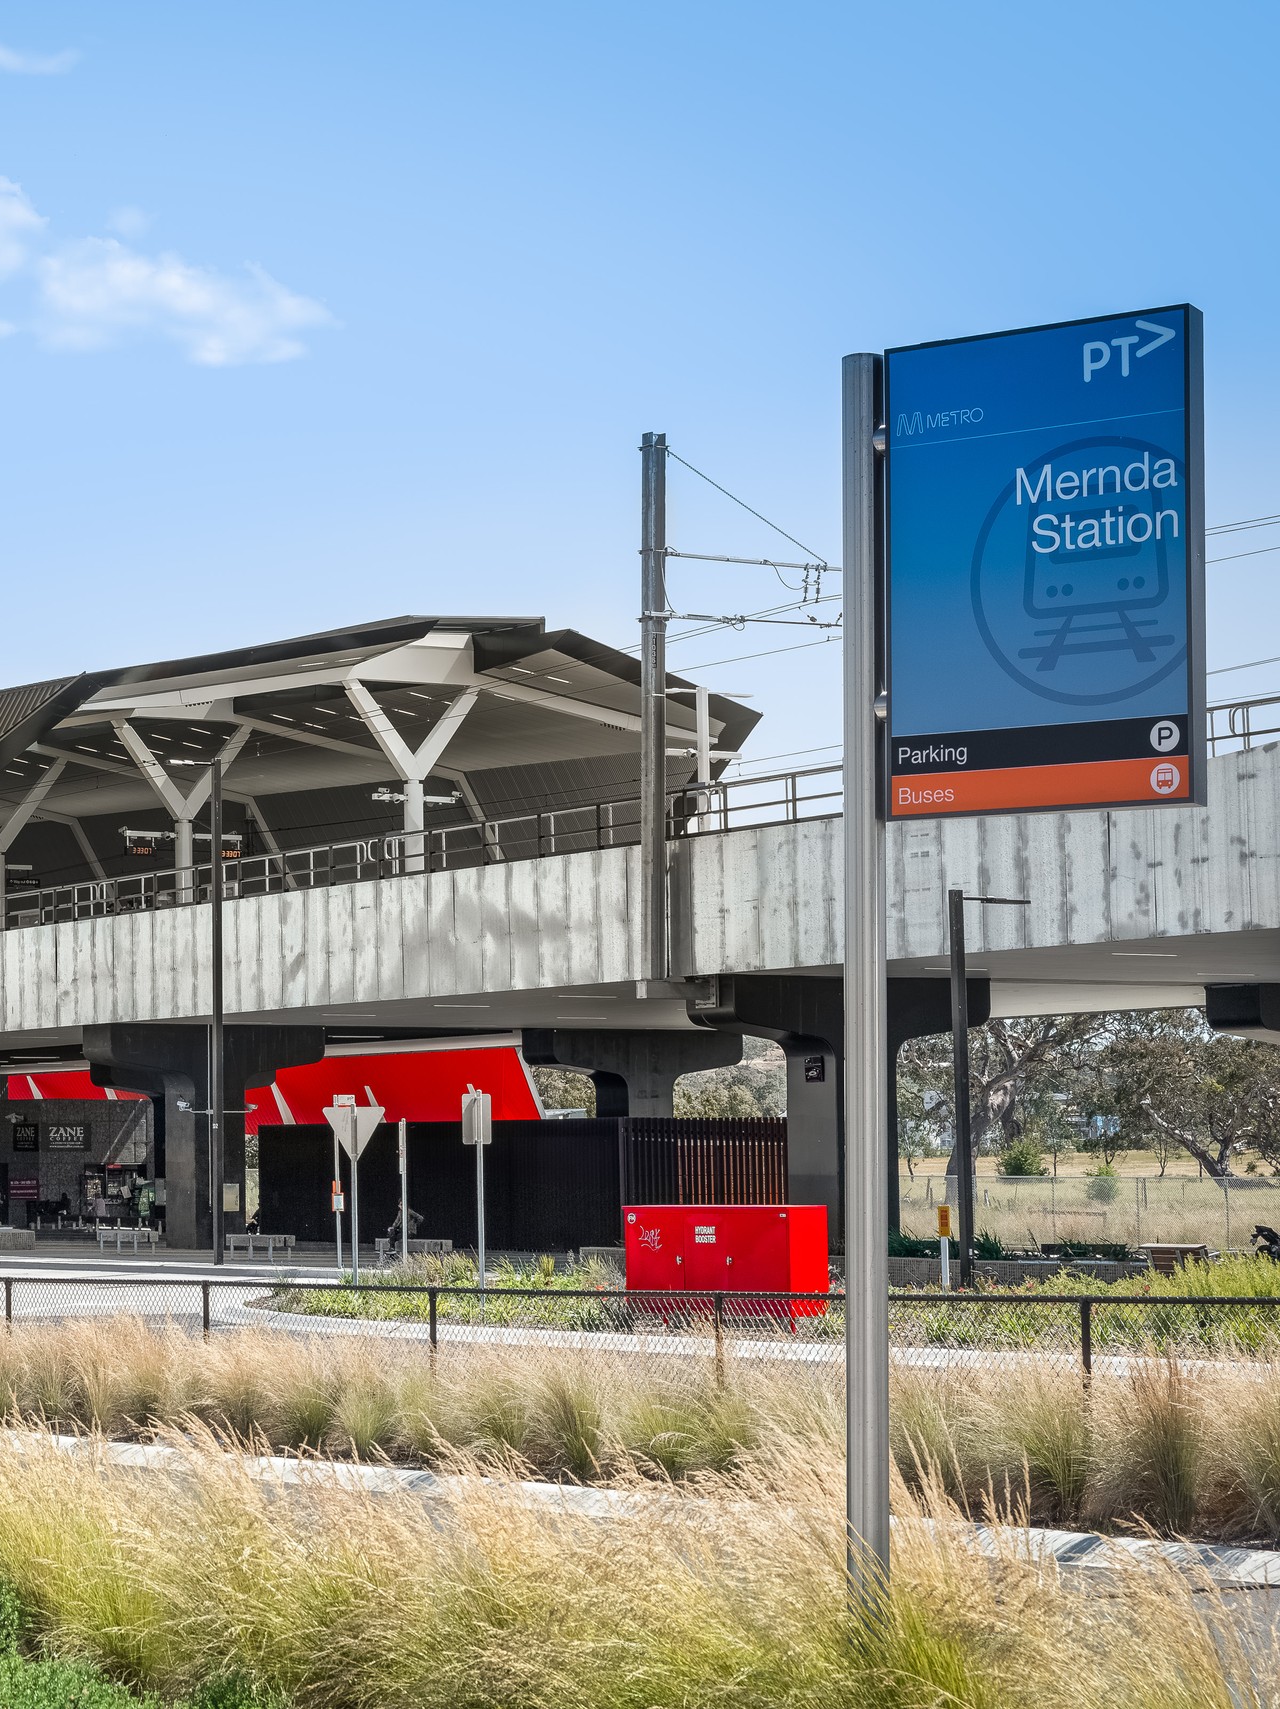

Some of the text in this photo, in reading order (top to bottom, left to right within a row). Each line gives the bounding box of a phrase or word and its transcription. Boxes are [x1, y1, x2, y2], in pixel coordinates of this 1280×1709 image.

[926, 407, 984, 429] METRO
[1016, 451, 1178, 506] Mernda
[1031, 505, 1179, 554] Station
[898, 744, 967, 765] Parking
[898, 787, 955, 805] Buses
[16, 1127, 35, 1137] ZANE
[49, 1126, 85, 1137] ZANE
[694, 1226, 715, 1234] HYDRANT
[695, 1235, 716, 1243] BOOSTER
